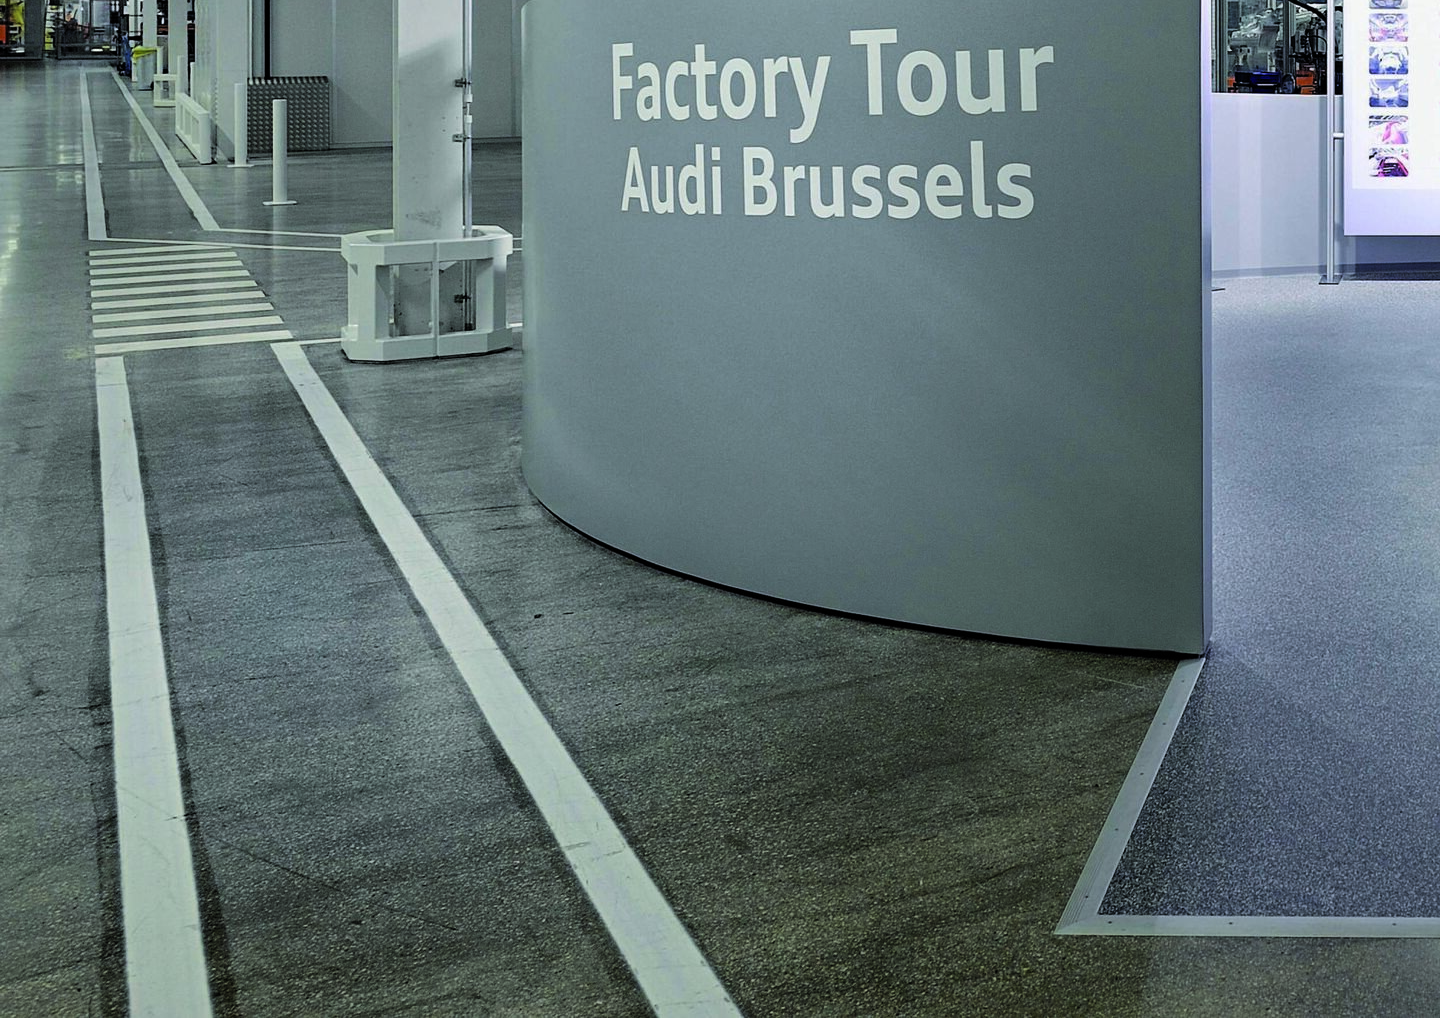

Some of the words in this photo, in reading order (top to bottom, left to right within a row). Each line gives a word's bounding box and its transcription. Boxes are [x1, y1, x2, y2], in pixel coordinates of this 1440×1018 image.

[611, 42, 831, 144] Factory
[850, 29, 1054, 116] Tour
[621, 143, 722, 215] Audi
[743, 141, 1035, 219] Brussels
